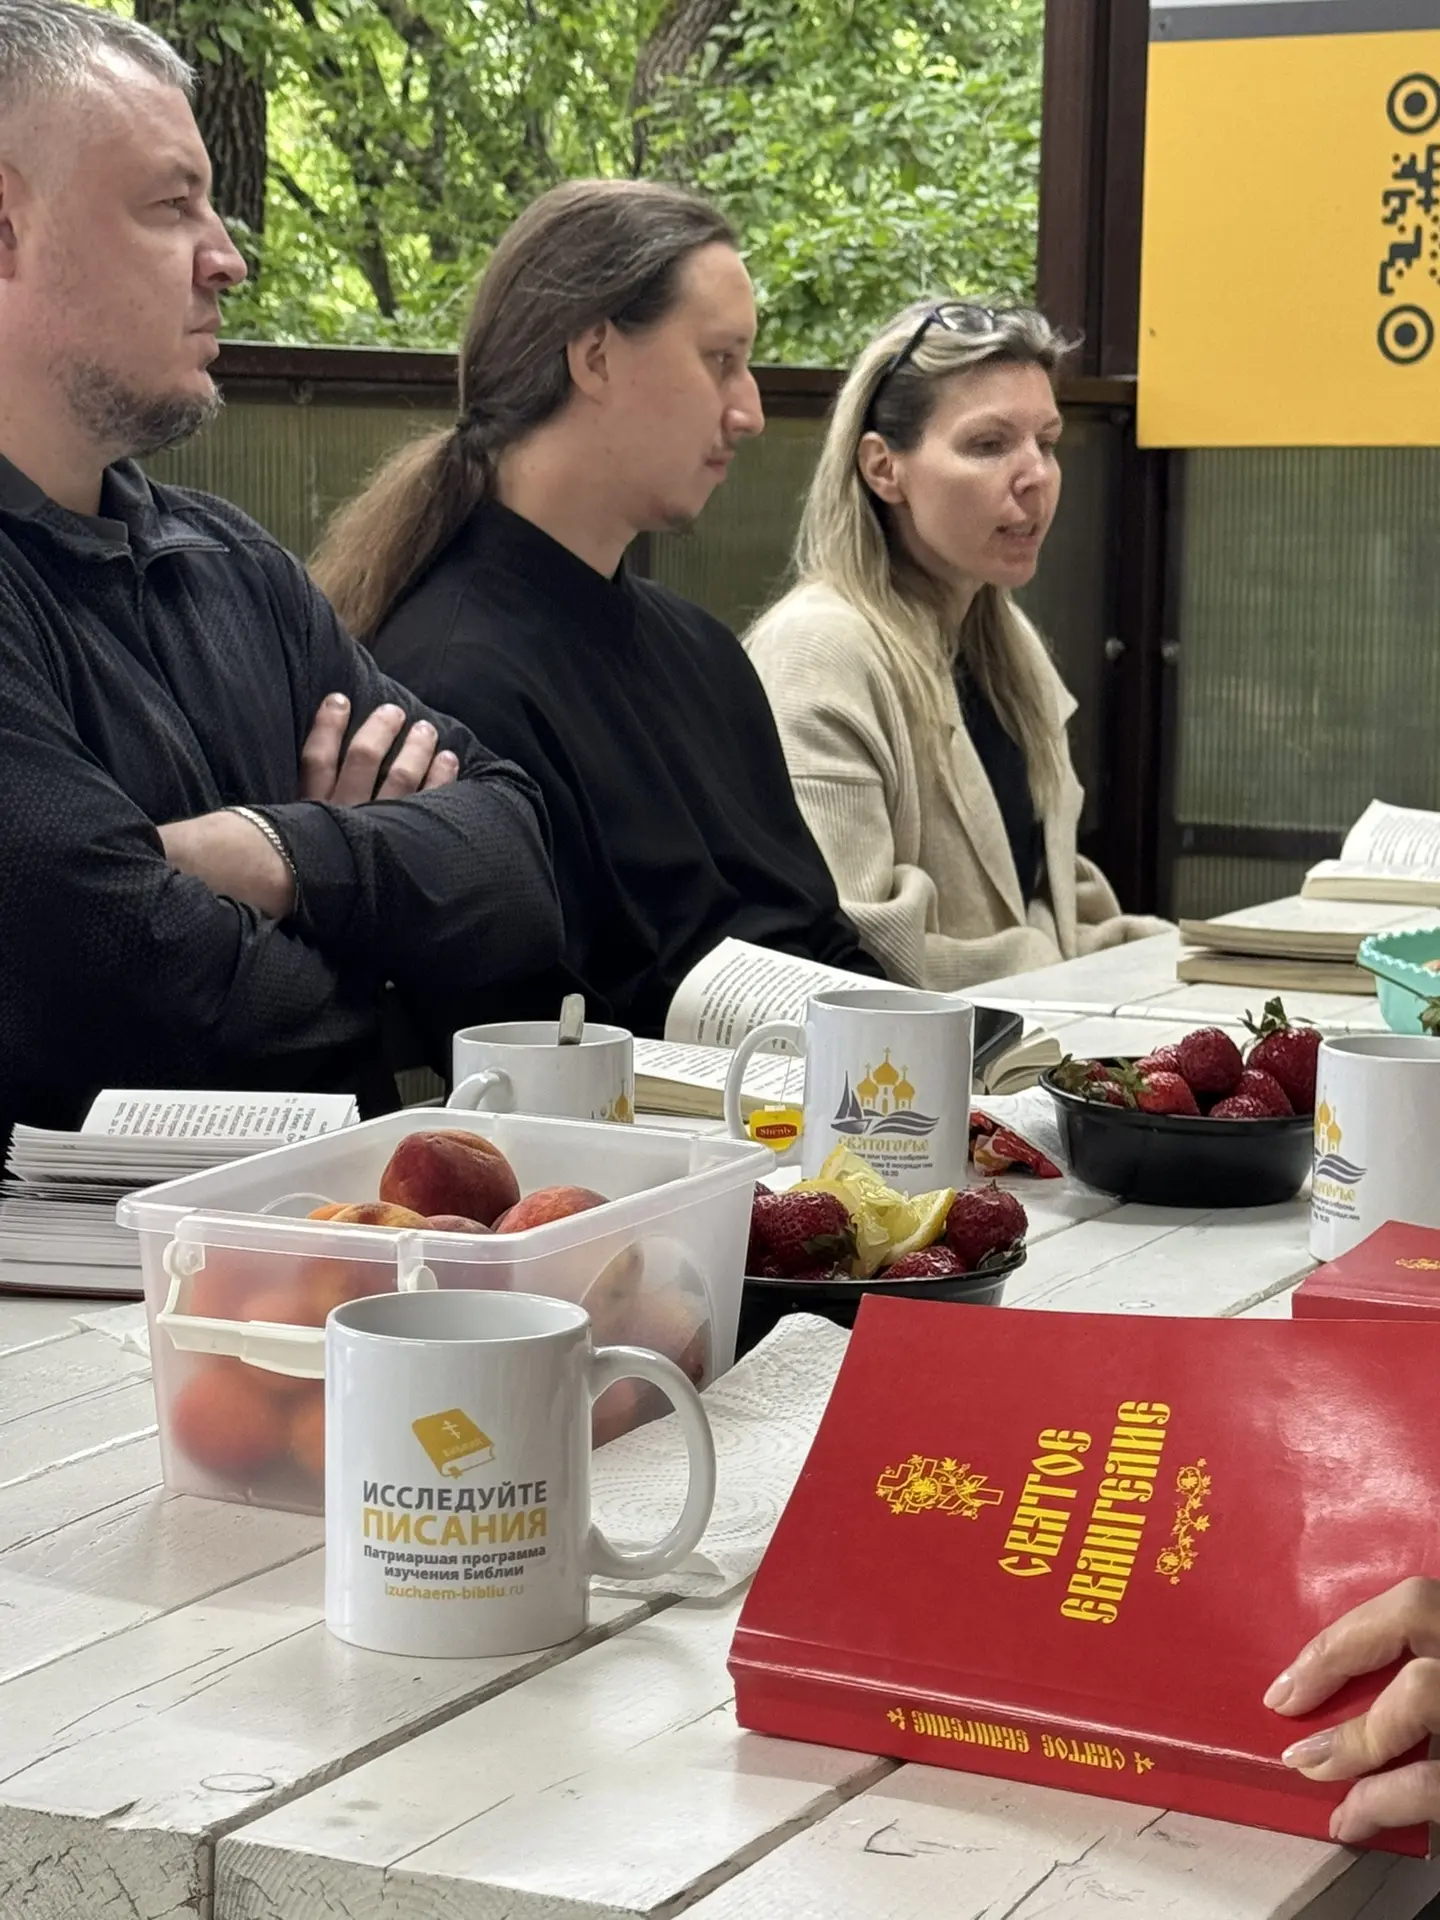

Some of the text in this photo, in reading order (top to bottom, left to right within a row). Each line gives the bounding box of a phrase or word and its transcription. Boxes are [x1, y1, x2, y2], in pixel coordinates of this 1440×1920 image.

[363, 1480, 547, 1513] ИССЛЕДУЙТЕ
[998, 1428, 1092, 1577] СВЯТОЕ
[1060, 1401, 1171, 1624] ЕВАНГЕЛИЕ
[363, 1507, 547, 1546] ПИСАНИЯ
[363, 1544, 547, 1567] Патриаршая программа
[384, 1565, 525, 1582] изучения Библии
[384, 1582, 525, 1600] izuchaem-bibliu.ru
[913, 1711, 1126, 1771] СВЯТОЕ ЕВАНГЕЛИЕ
